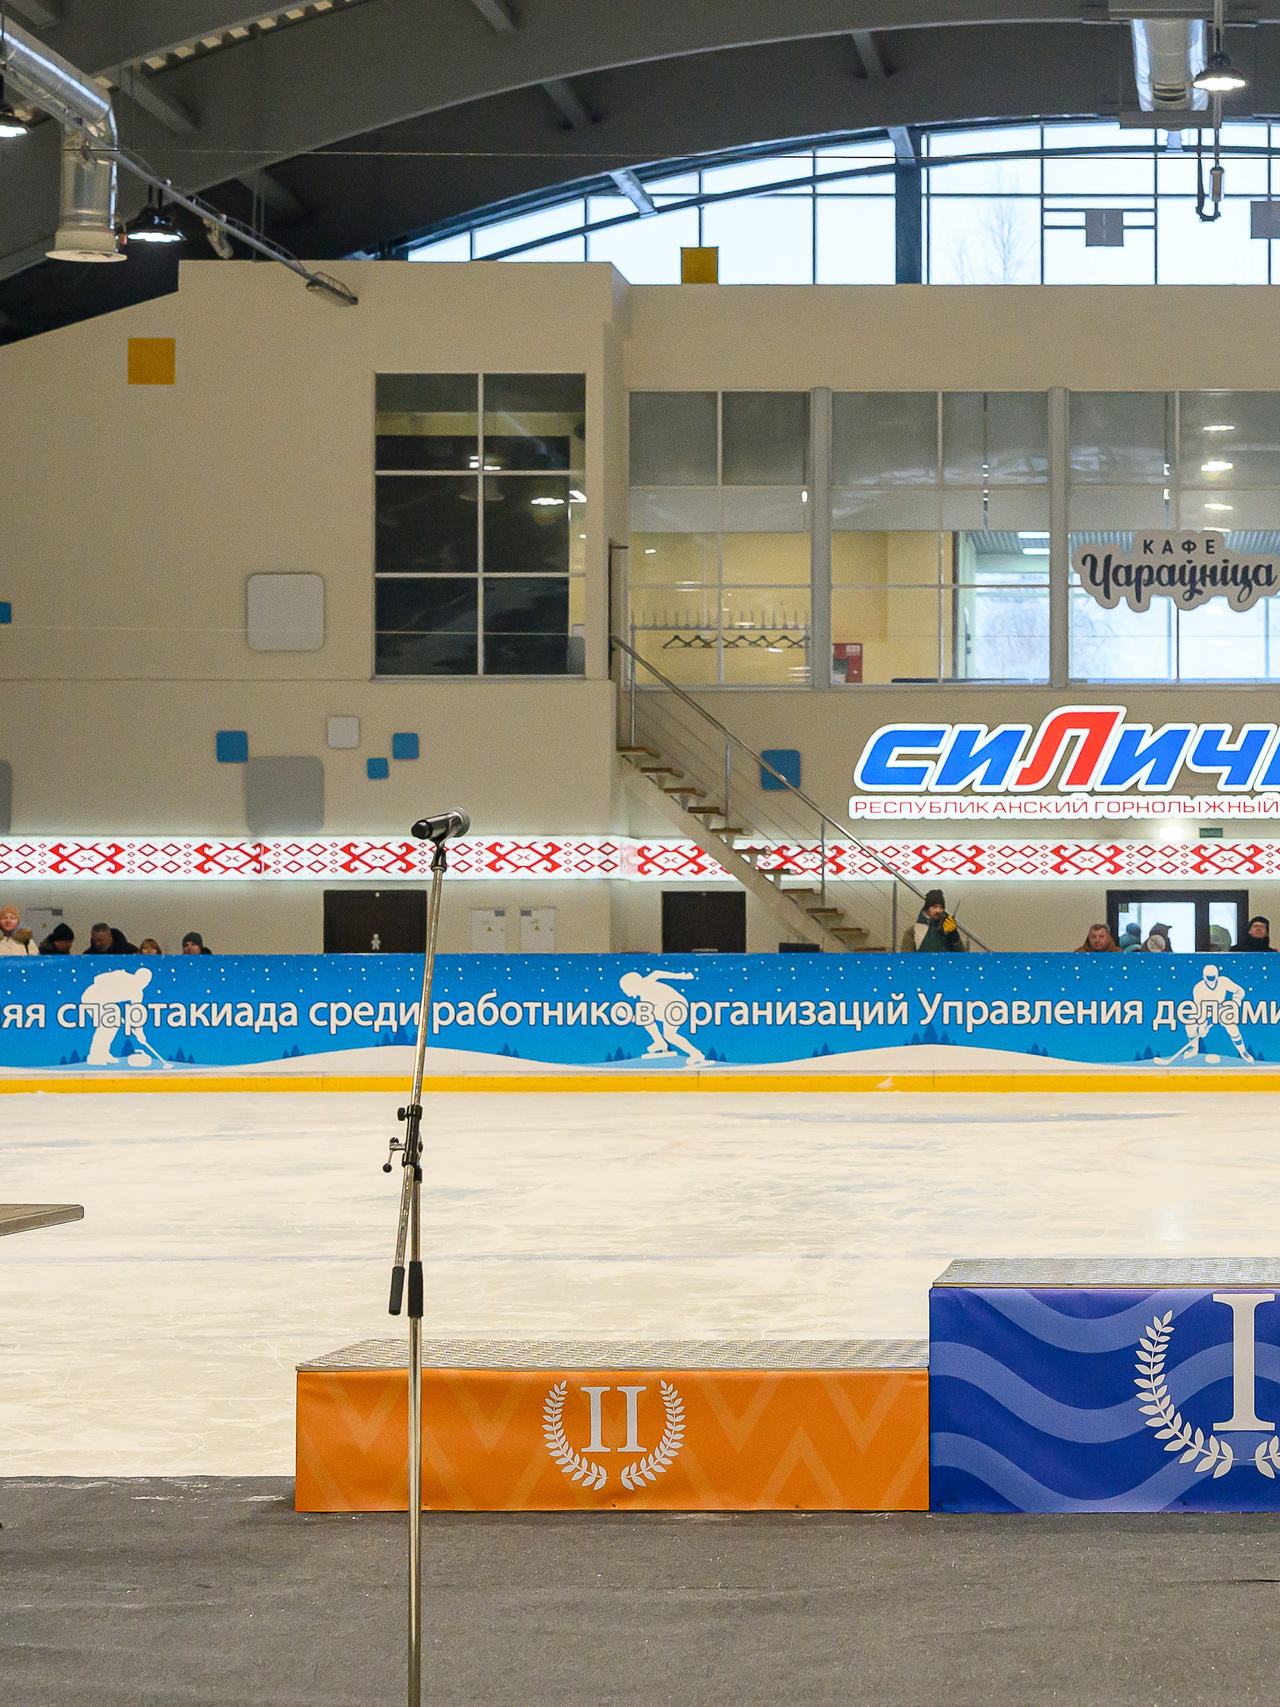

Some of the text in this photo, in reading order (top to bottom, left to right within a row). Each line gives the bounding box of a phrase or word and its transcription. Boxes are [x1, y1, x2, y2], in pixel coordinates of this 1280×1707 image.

[1142, 538, 1216, 555] КАФЕ
[854, 797, 1088, 814] РЕСПУБЛИКАНСКИЙ
[1094, 797, 1279, 814] ГОРНОЛЫЖНЫЙ
[56, 1001, 299, 1037] спартакиада
[308, 1001, 423, 1035] среди
[432, 991, 656, 1035] работников
[664, 991, 909, 1035] организаций
[917, 991, 1143, 1034] Управления
[579, 1385, 648, 1454] II
